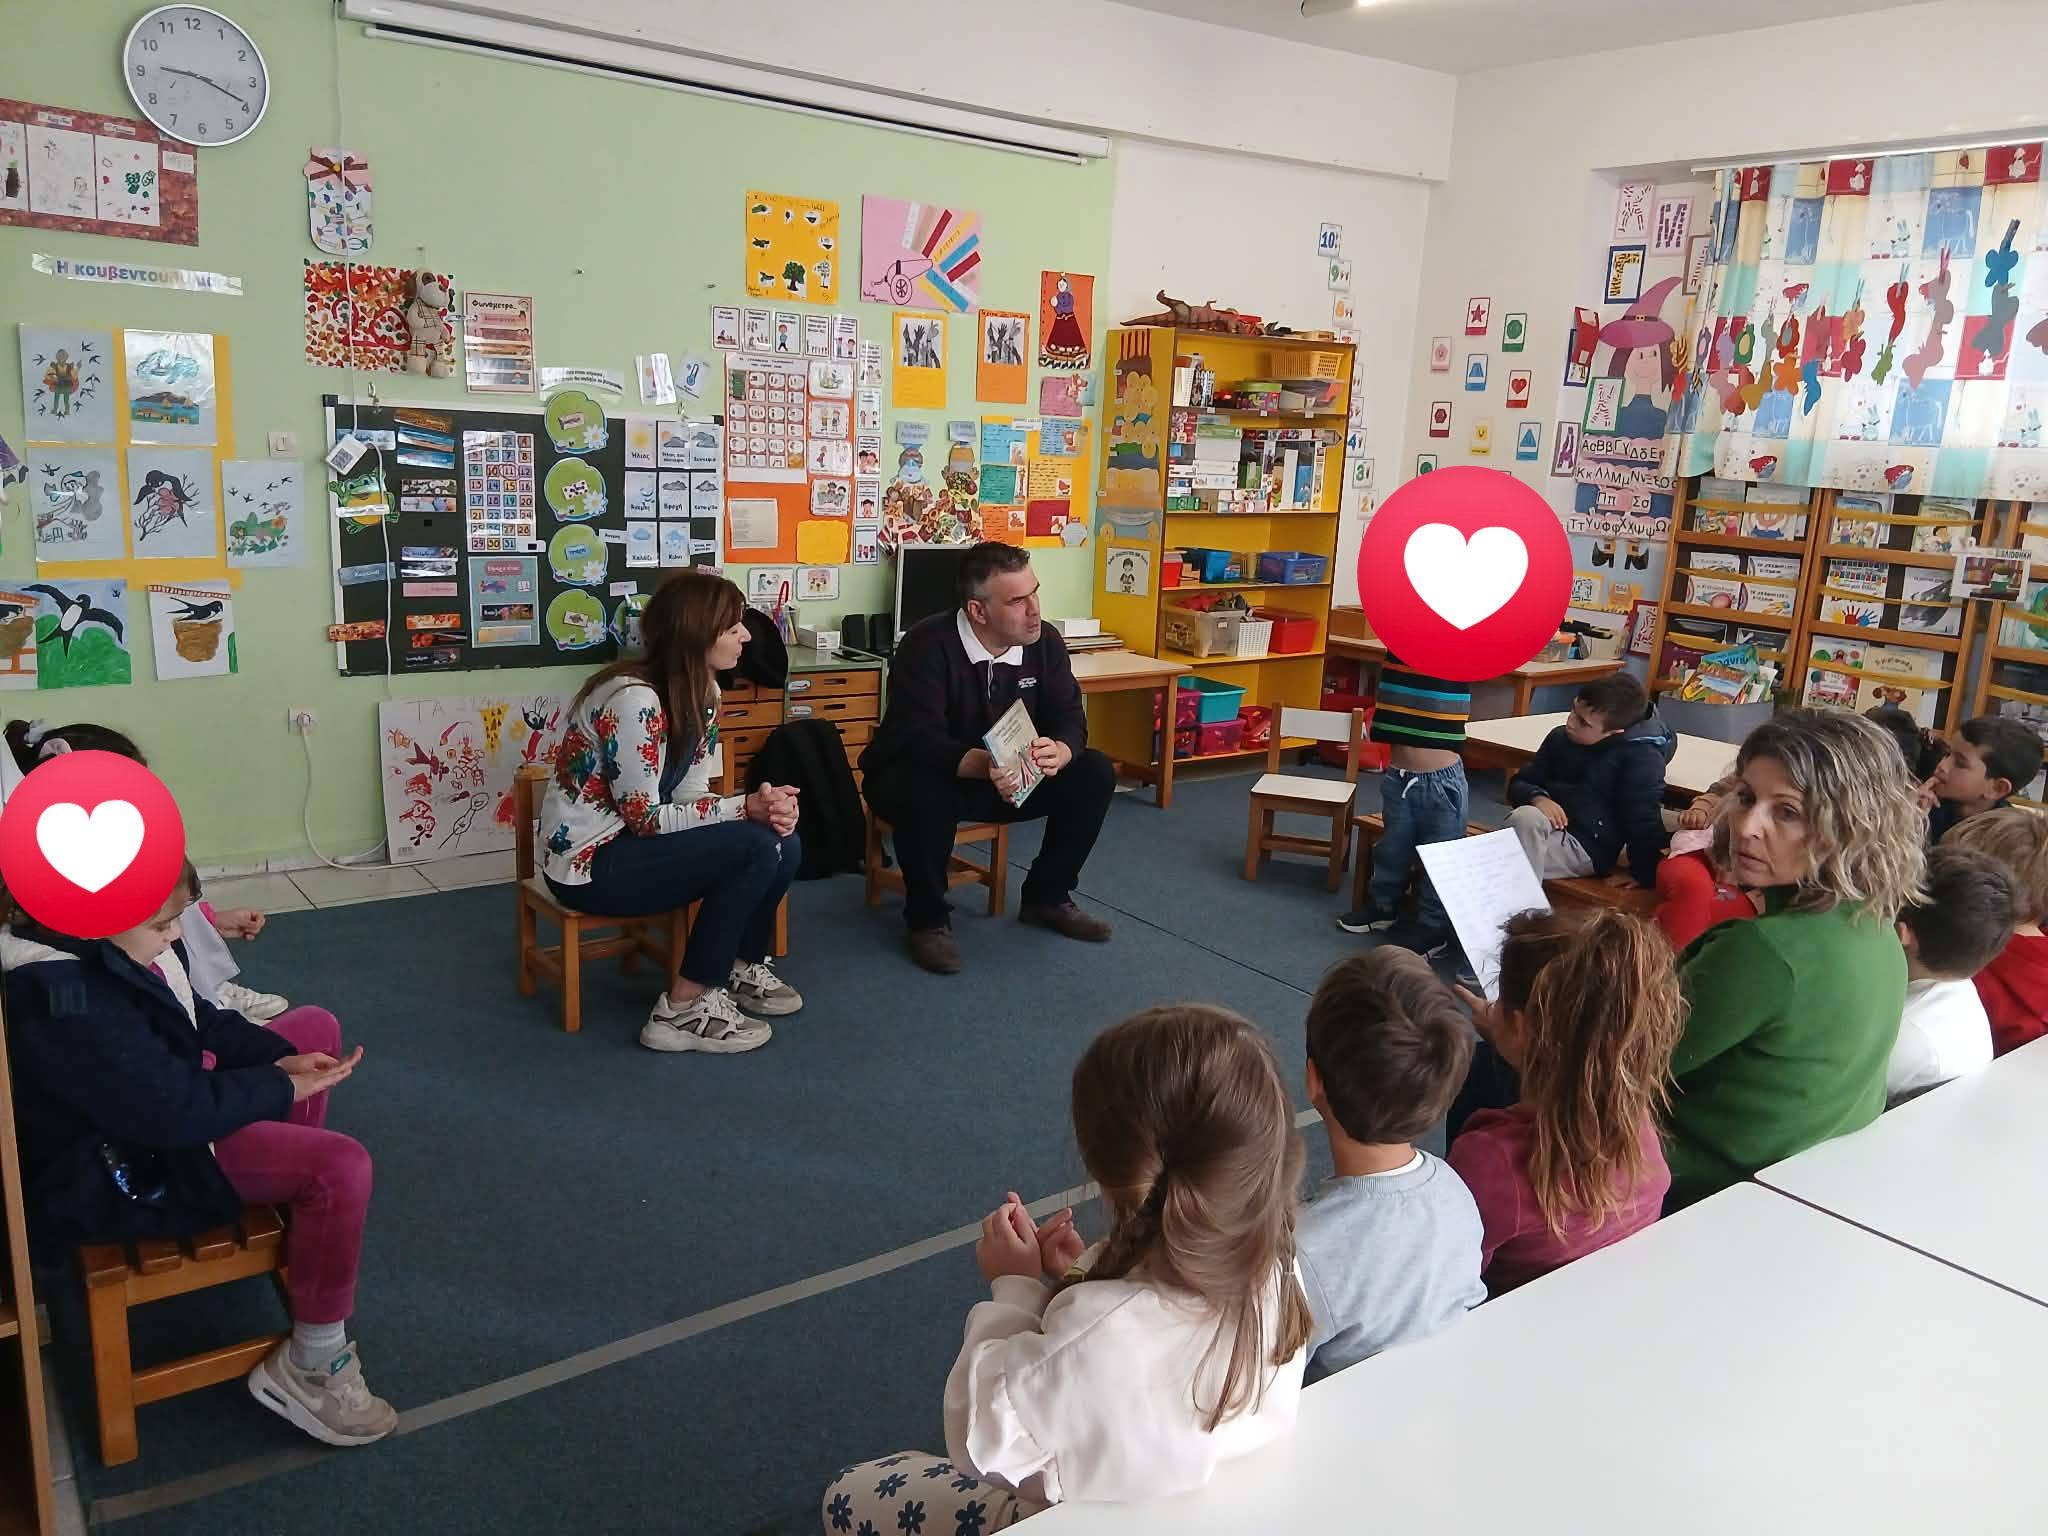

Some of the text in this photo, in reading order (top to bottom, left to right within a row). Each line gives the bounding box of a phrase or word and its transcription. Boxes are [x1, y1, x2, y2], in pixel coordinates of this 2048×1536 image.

[159, 21, 174, 34] 11
[184, 17, 201, 31] 12
[217, 28, 224, 41] 1
[141, 39, 158, 51] 10
[237, 50, 247, 62] 2
[136, 64, 146, 77] 9
[248, 76, 257, 89] 3
[148, 92, 158, 105] 8
[241, 102, 250, 114] 4
[168, 113, 178, 127] 7
[225, 118, 234, 130] 5
[198, 122, 207, 135] 6
[1320, 231, 1336, 249] 10
[56, 260, 69, 275] Η
[1331, 264, 1339, 282] 9
[1348, 434, 1357, 451] 4
[506, 451, 512, 459] 7
[521, 452, 528, 461] 8
[473, 465, 531, 476] 9 10 11 12
[1355, 464, 1365, 482] 3
[471, 481, 531, 492] 13 14 15 16
[471, 495, 533, 507] 17 18 19 20
[1360, 496, 1370, 513] 2
[472, 511, 532, 520] 21 22 23 24
[503, 525, 514, 534] 27
[518, 525, 530, 534] 28
[473, 539, 514, 548] 29 30 31
